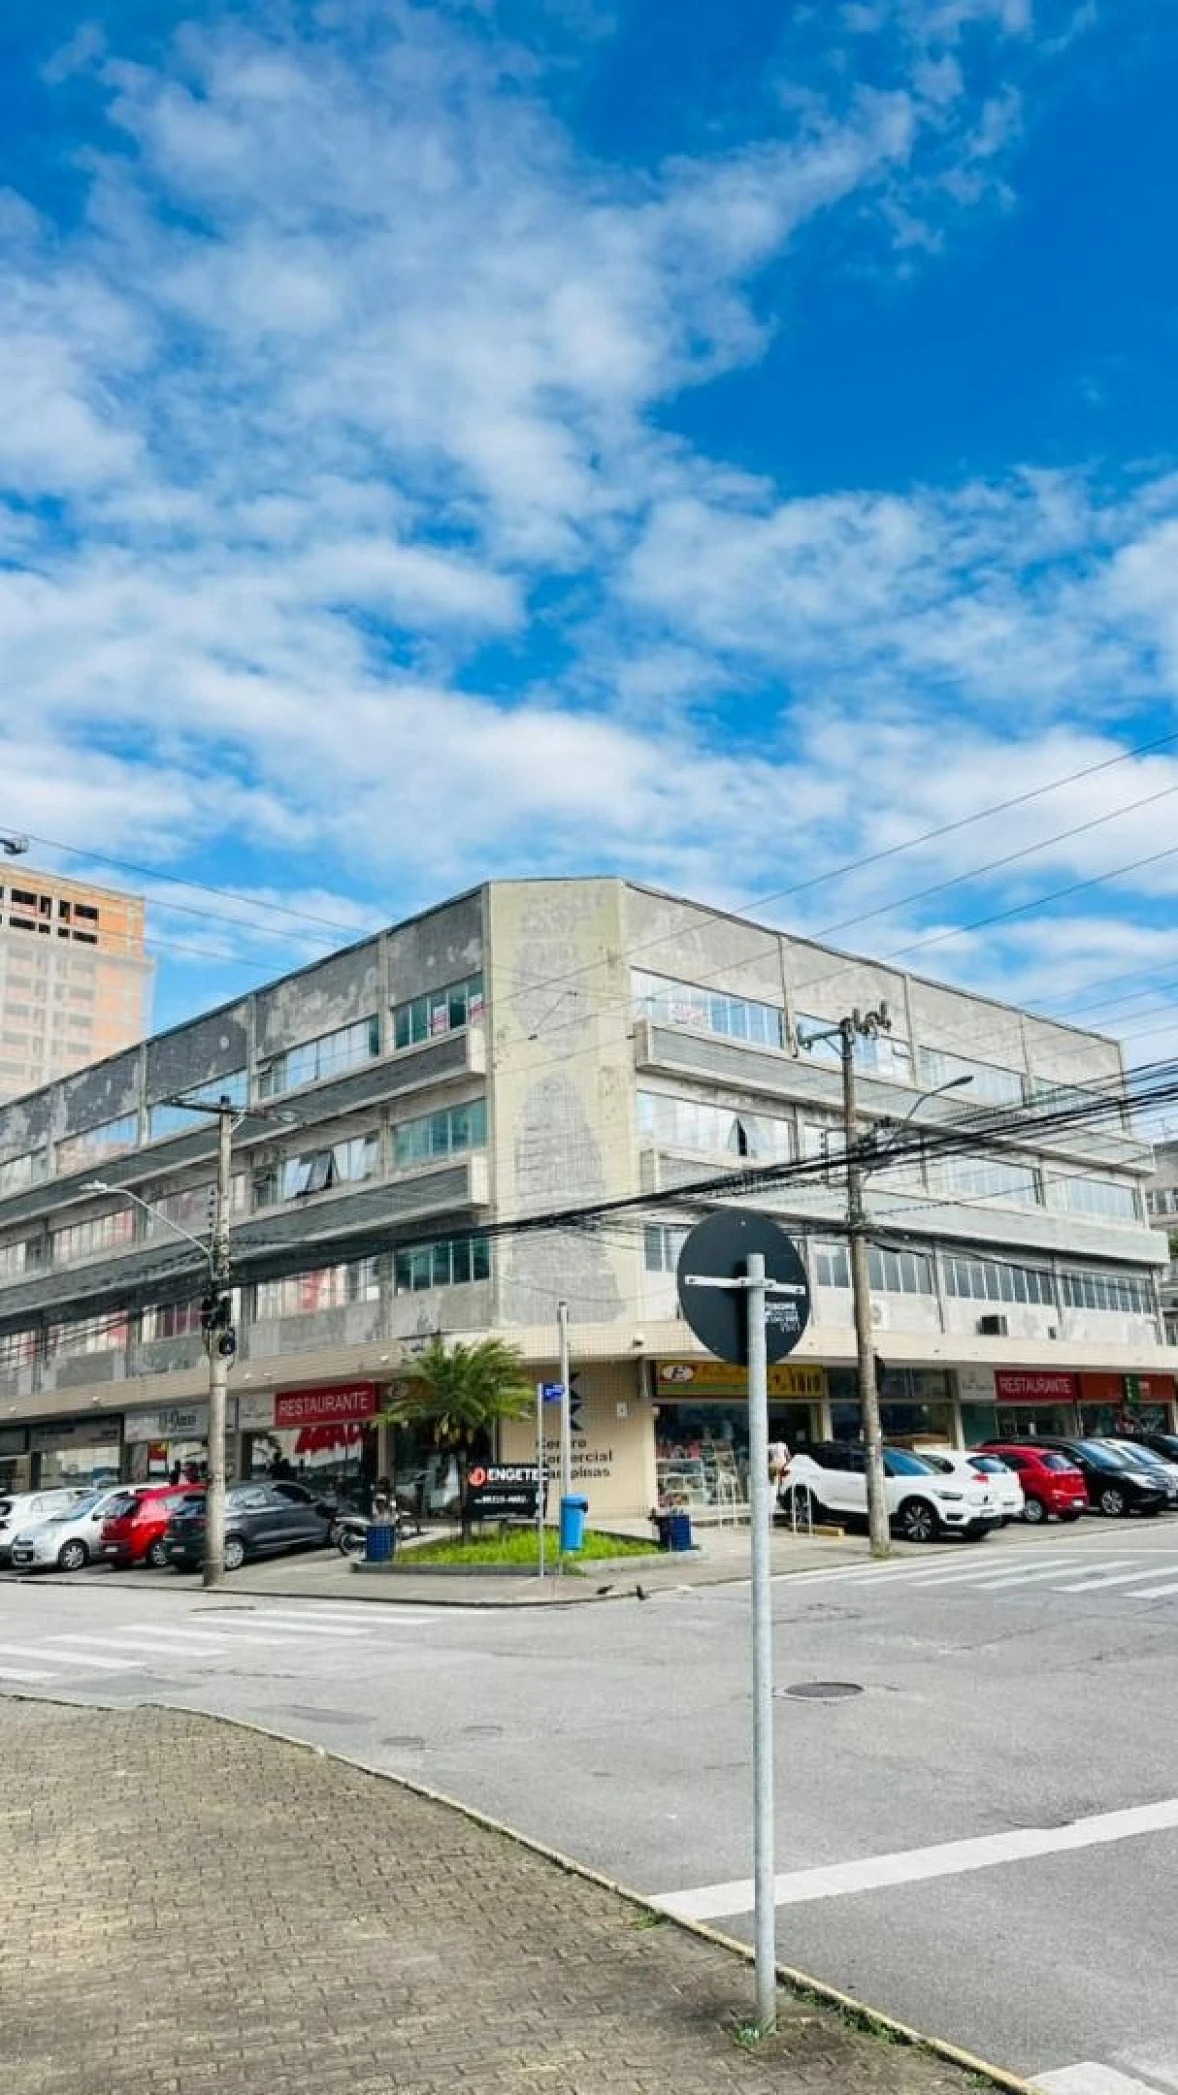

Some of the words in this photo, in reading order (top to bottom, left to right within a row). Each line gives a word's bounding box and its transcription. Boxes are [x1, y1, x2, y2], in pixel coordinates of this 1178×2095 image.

[1000, 1377, 1071, 1394] RESTAURANTE
[280, 1390, 368, 1416] RESTAURANTE
[536, 1450, 613, 1463] Coercial
